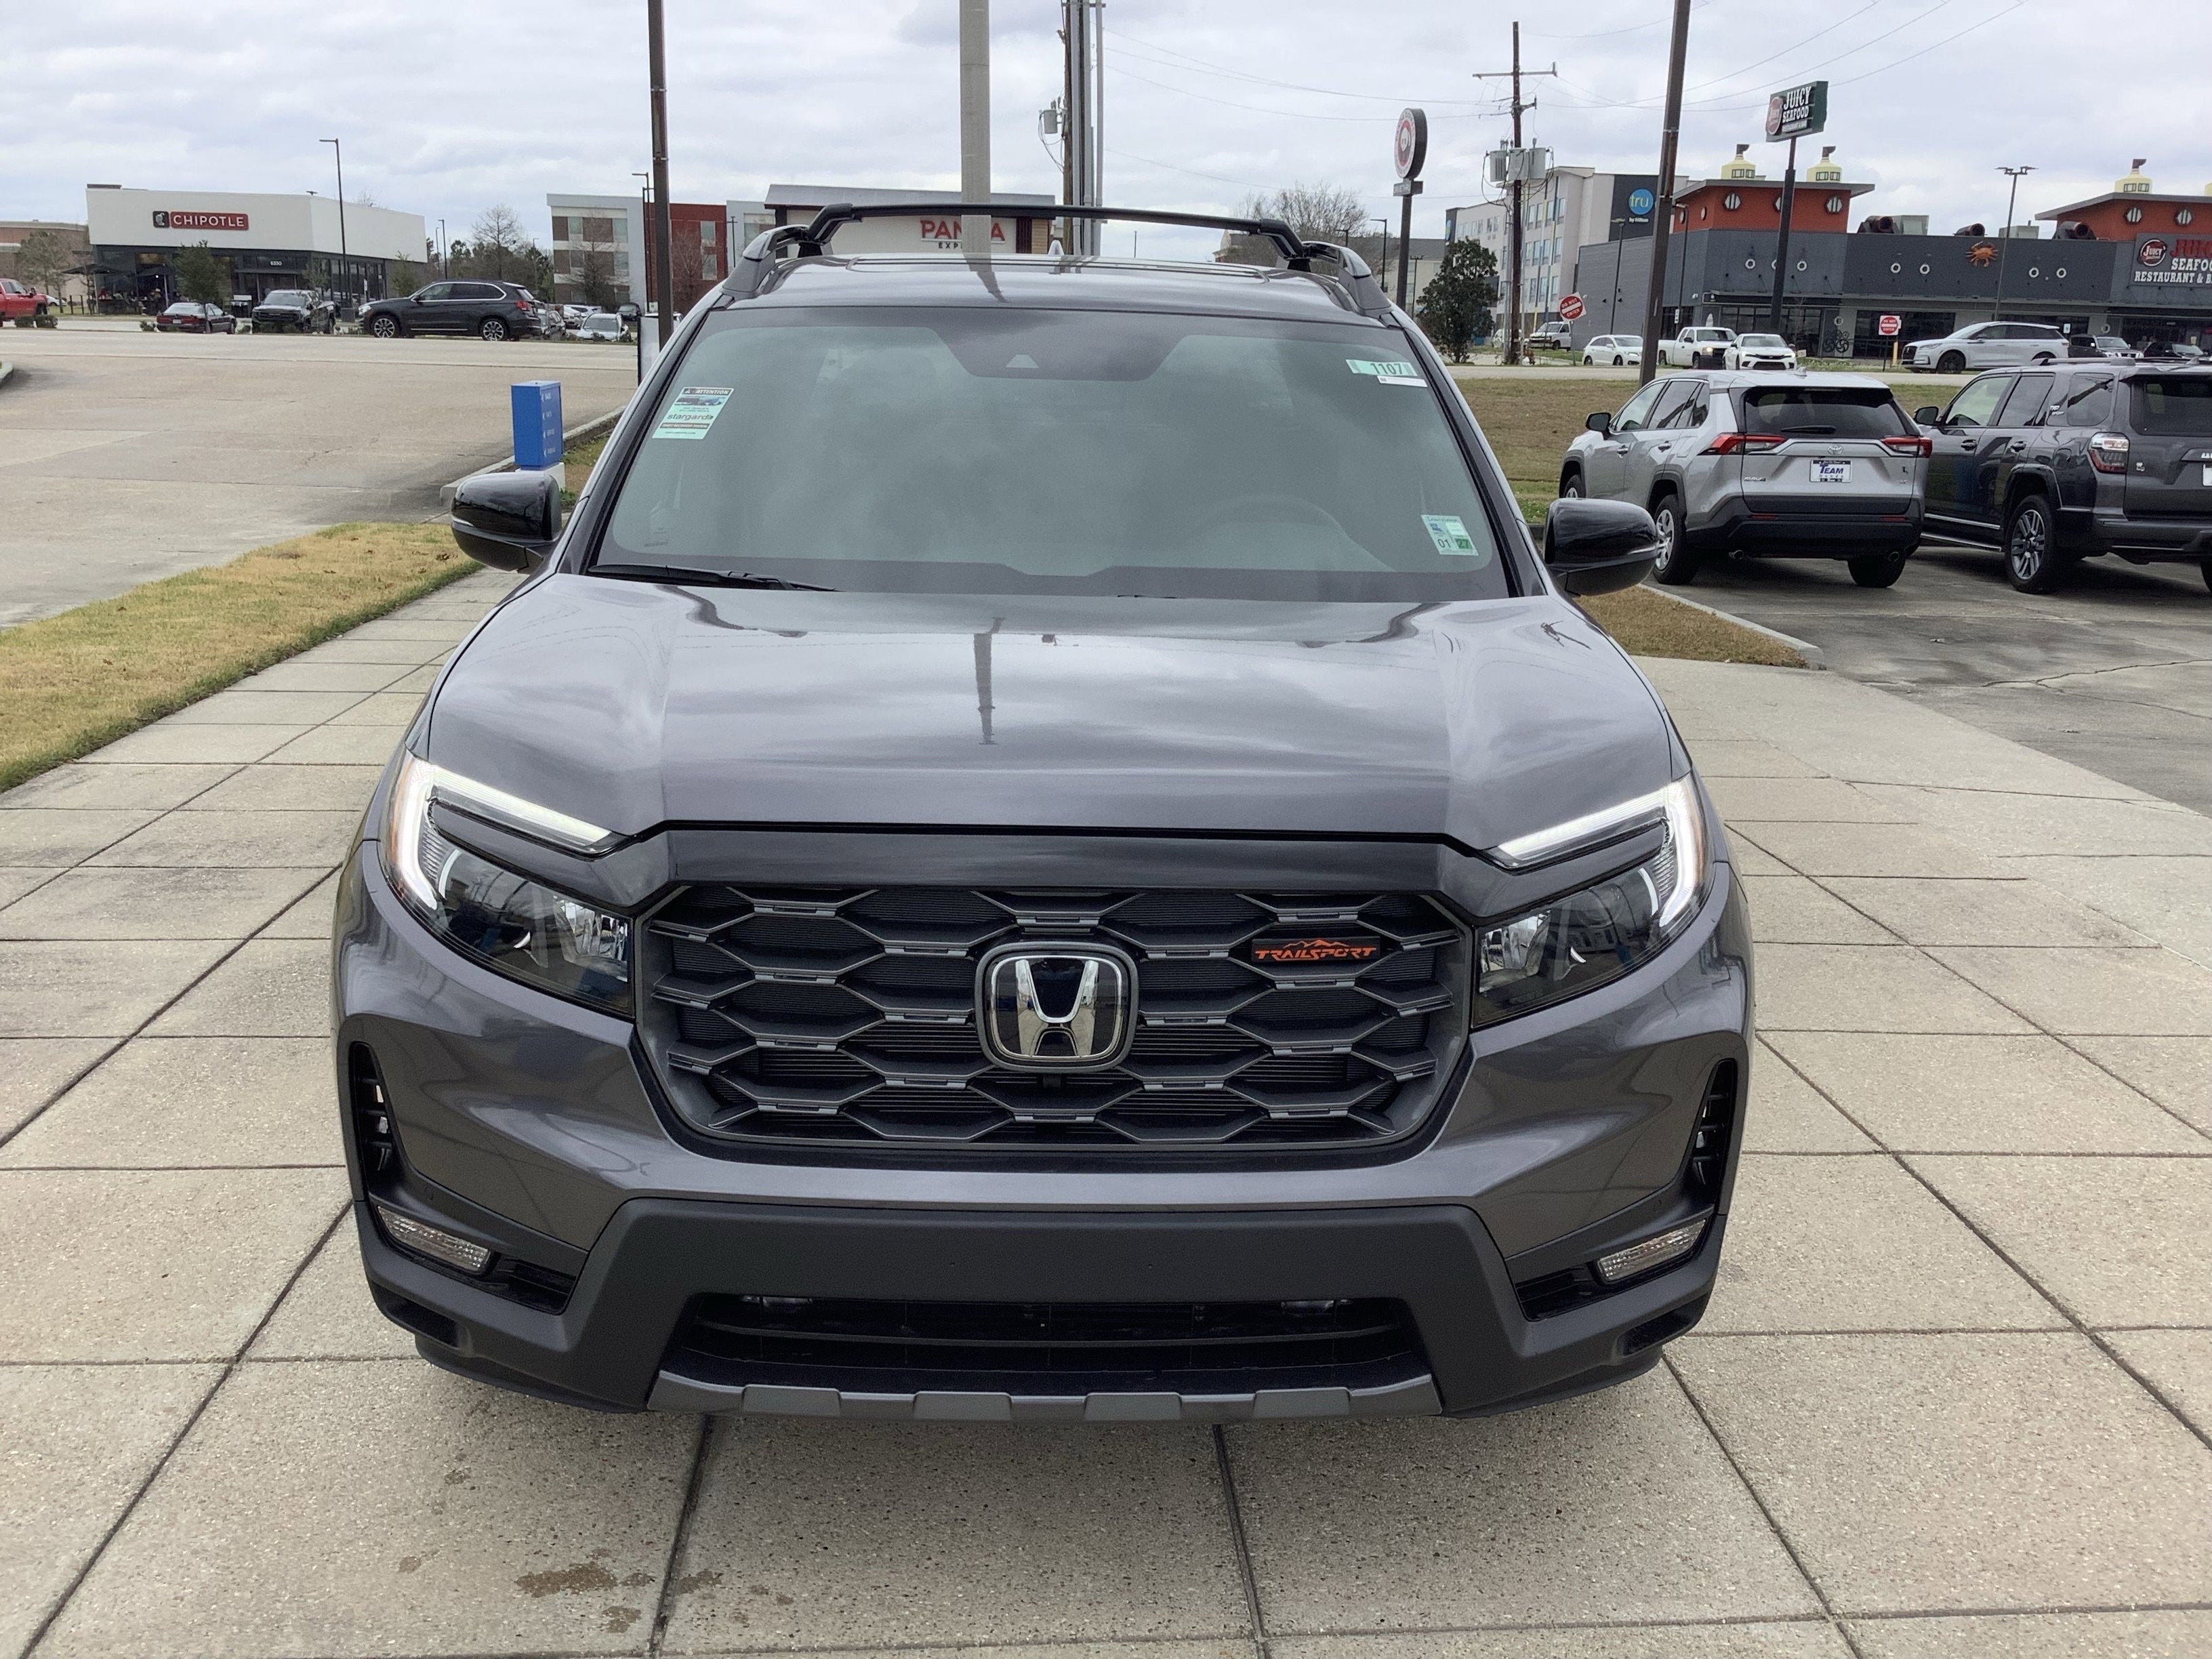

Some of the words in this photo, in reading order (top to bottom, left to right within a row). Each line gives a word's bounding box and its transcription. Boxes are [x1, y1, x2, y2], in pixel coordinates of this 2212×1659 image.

[1784, 86, 1811, 110] JUICY
[1782, 106, 1809, 123] SEAFOOD
[1631, 194, 1649, 208] tru
[173, 214, 245, 228] CHIPOTLE
[920, 220, 1006, 241] PANA
[2134, 271, 2195, 283] RESTAURANT
[2196, 273, 2204, 284] &
[1566, 308, 1580, 317] ENTER
[1370, 363, 1403, 375] 1107
[1819, 463, 1844, 474] TEAM
[1437, 538, 1452, 548] 01
[1255, 947, 1377, 962] TRAILSPORT
